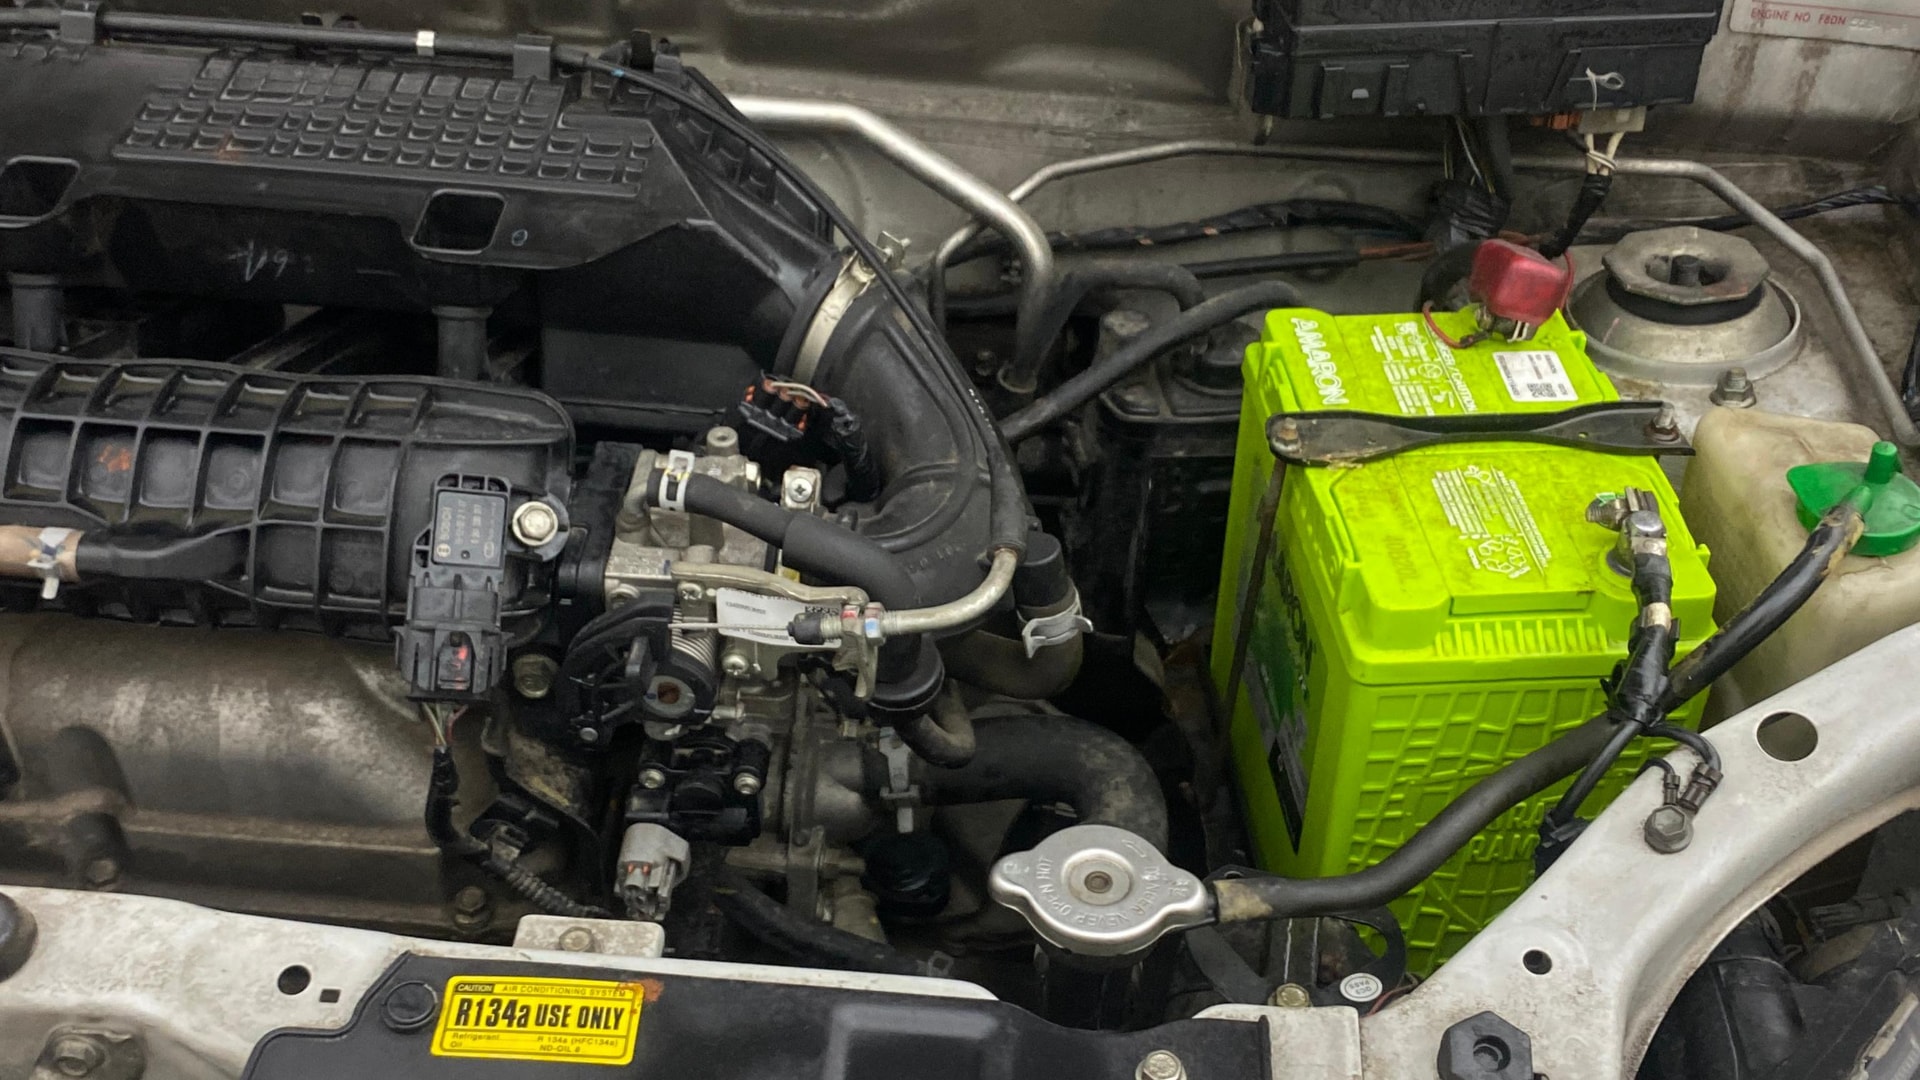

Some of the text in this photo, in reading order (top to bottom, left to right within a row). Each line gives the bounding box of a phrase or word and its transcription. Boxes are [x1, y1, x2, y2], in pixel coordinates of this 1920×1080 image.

[1750, 8, 1790, 21] ENGINE
[1793, 12, 1811, 22] NO
[1290, 317, 1350, 405] AMARON
[1036, 855, 1053, 880] HOT
[1076, 909, 1130, 927] NEVER
[458, 984, 493, 992] CAUTION
[520, 985, 587, 996] CONDITIONING
[589, 988, 626, 997] SYSTEM
[455, 998, 625, 1030] R134a USE ONLY
[452, 1032, 500, 1041] Refrigerant
[540, 1044, 572, 1052] ND-OIL
